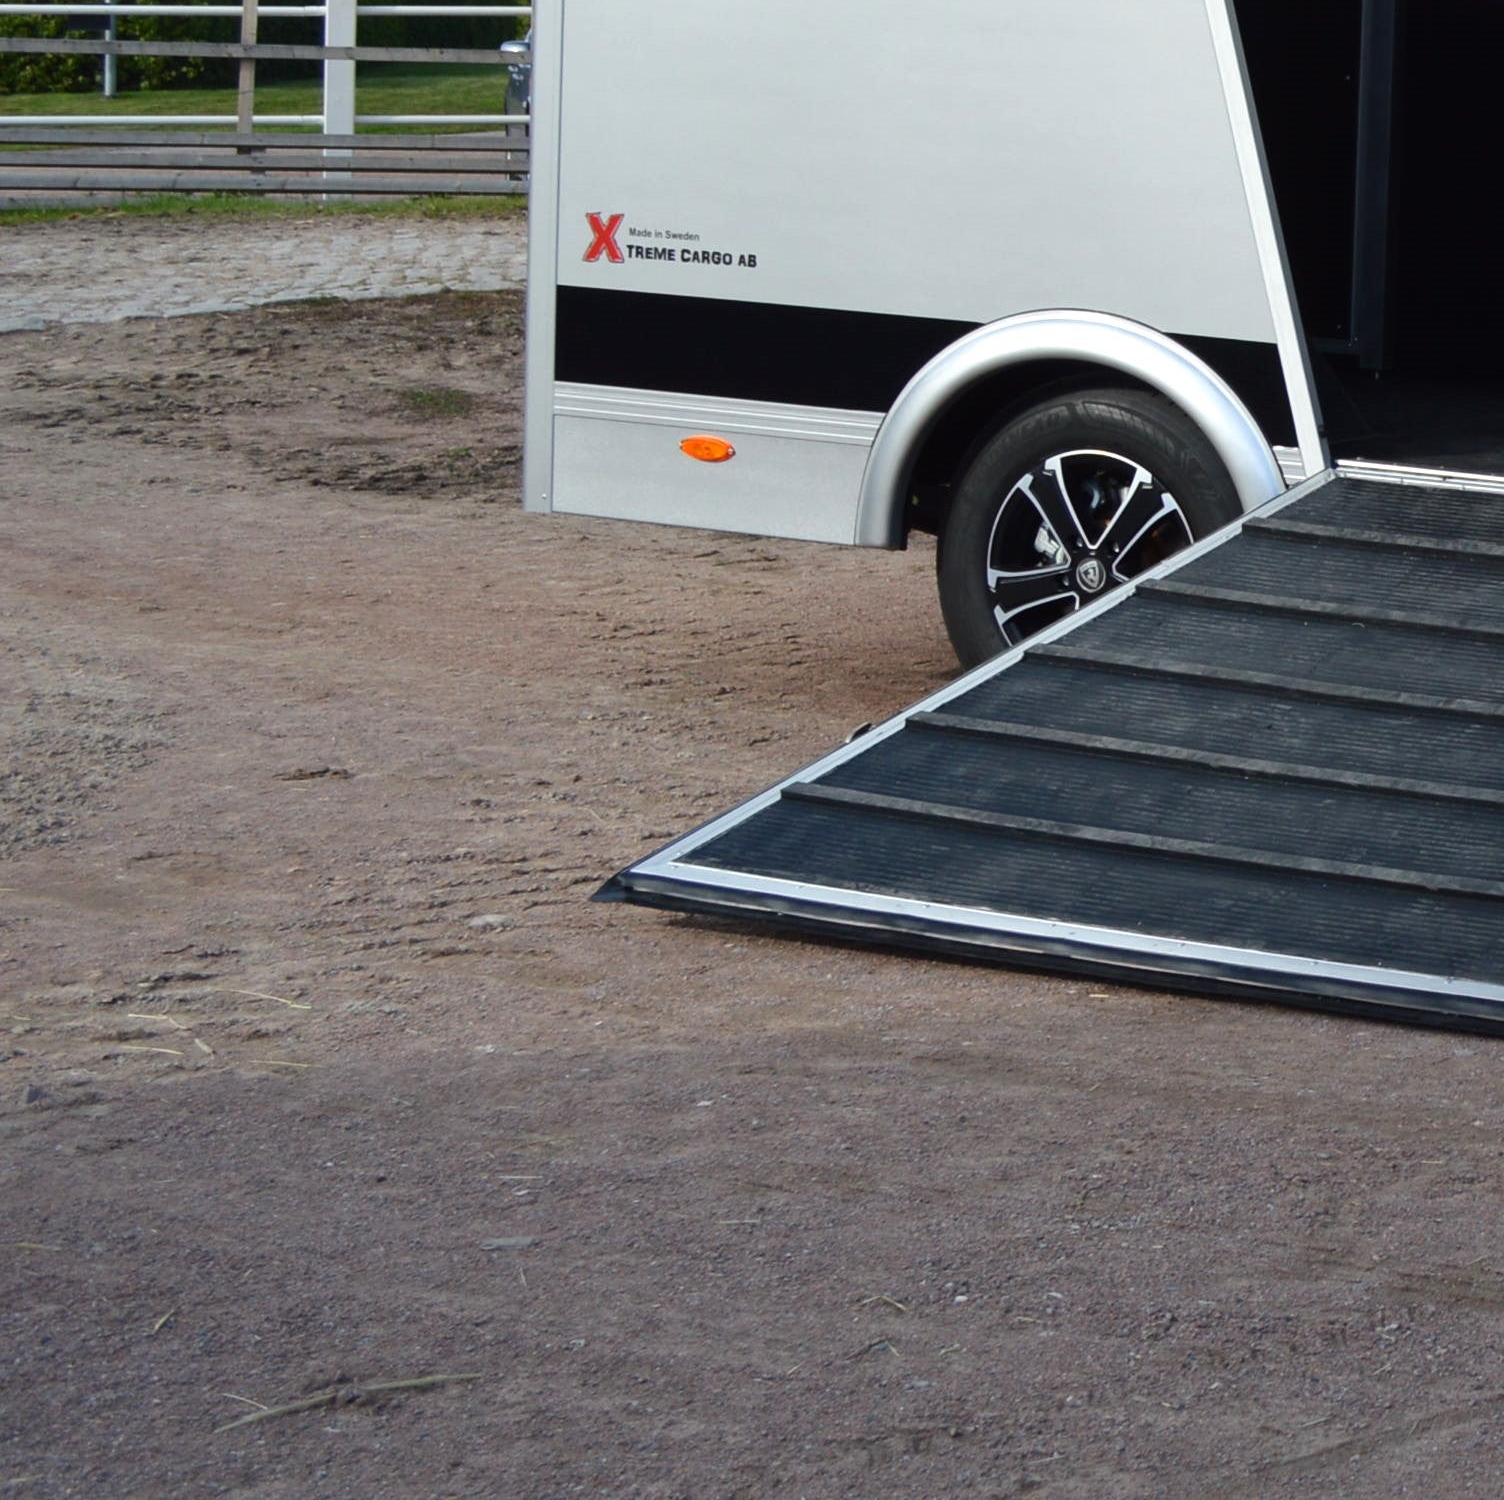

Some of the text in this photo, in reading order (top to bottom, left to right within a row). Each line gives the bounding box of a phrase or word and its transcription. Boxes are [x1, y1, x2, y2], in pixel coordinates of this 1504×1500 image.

[629, 227, 700, 241] Made in Sweden
[680, 249, 733, 266] CARGO
[738, 254, 758, 268] AB
